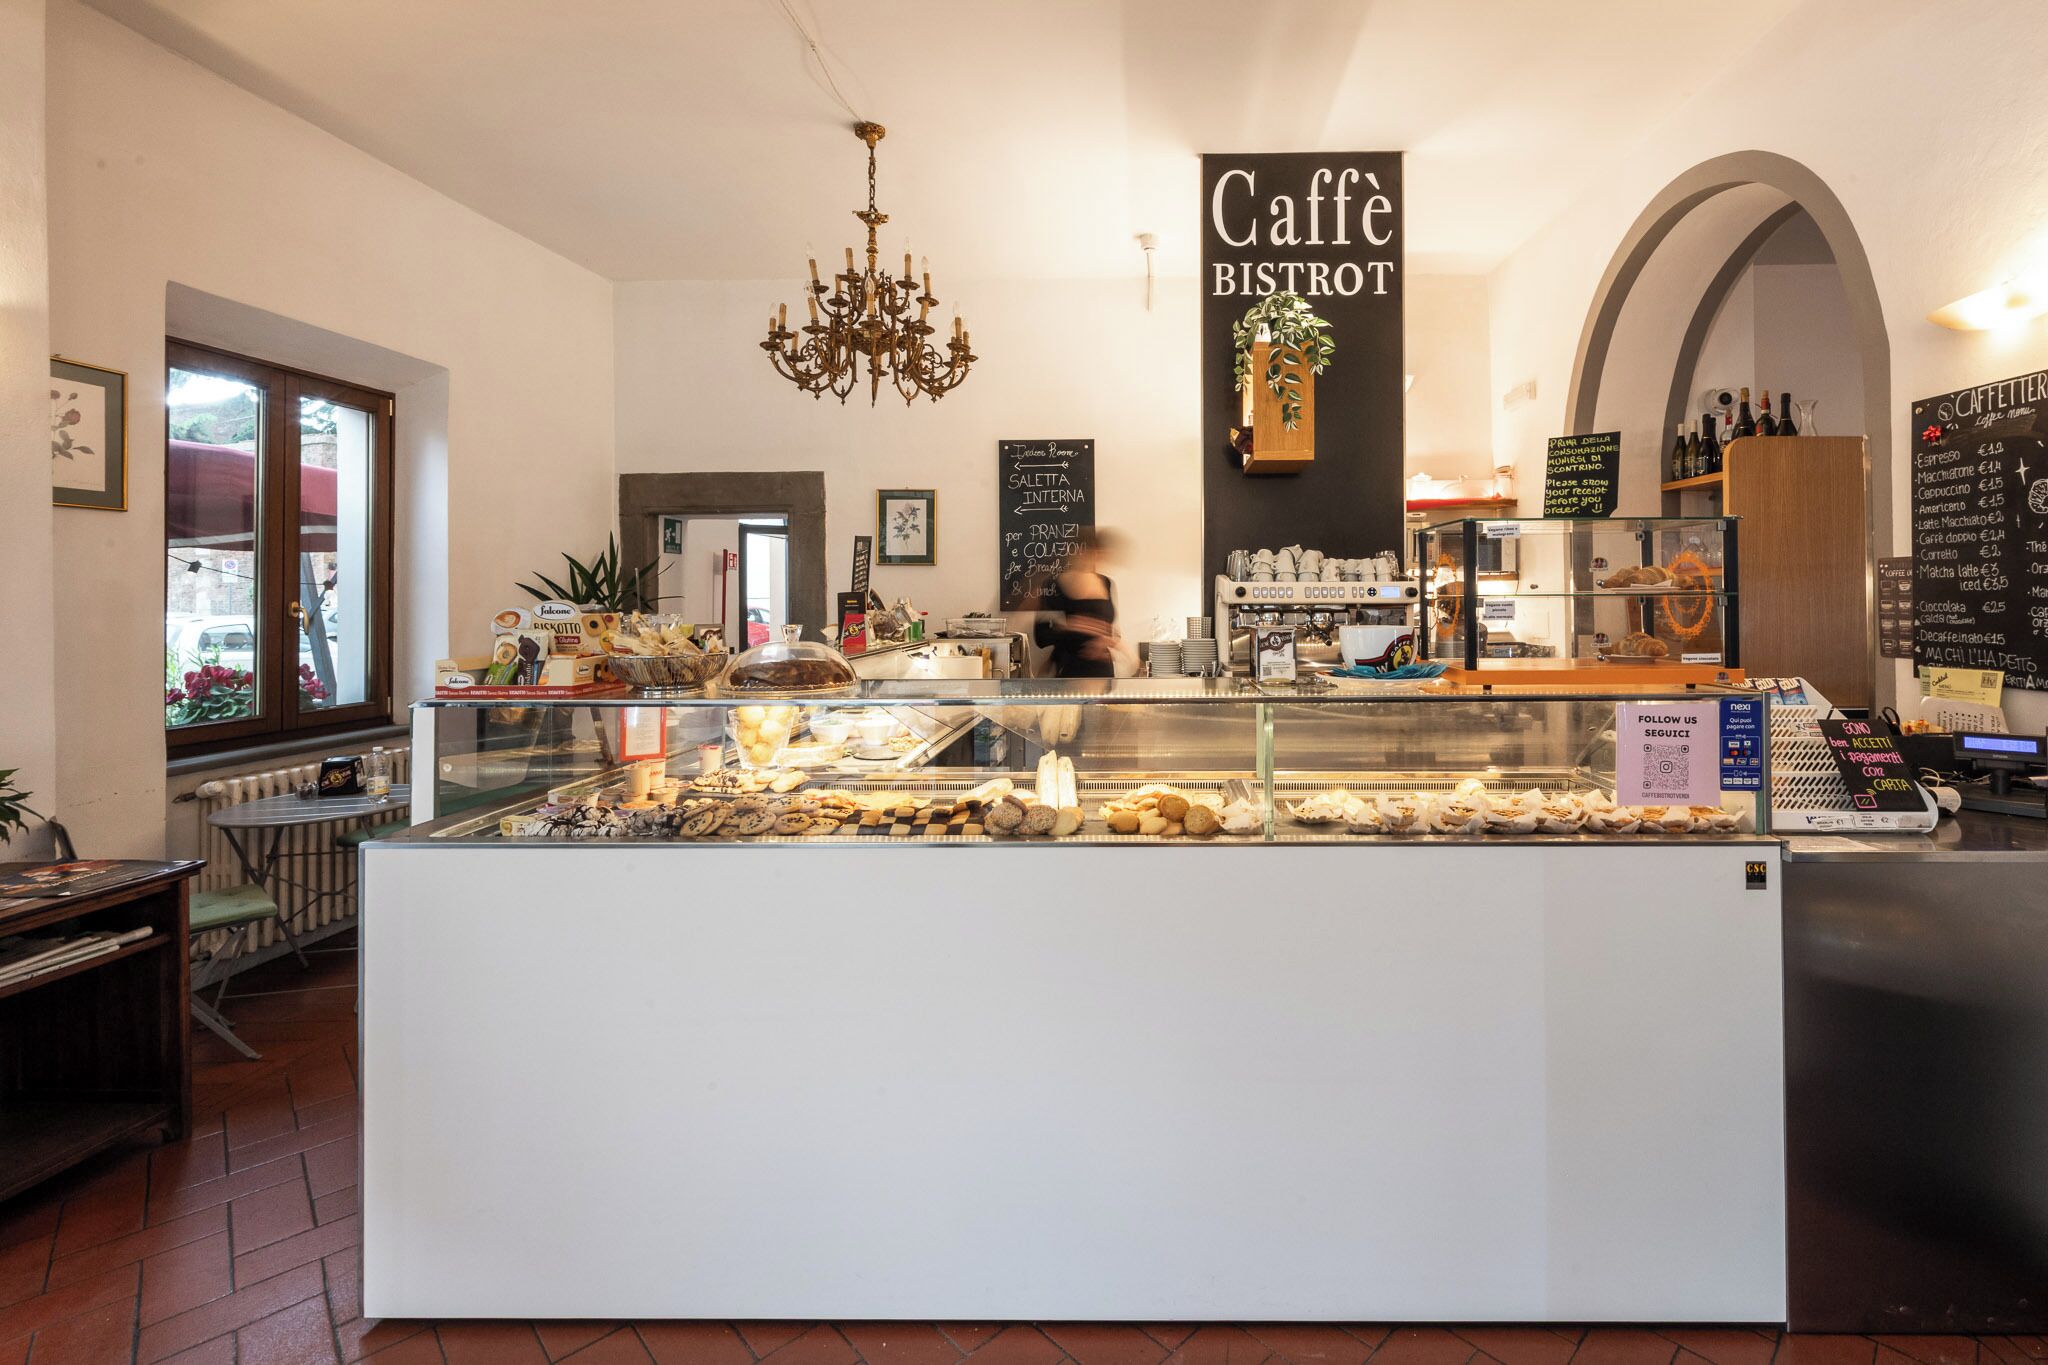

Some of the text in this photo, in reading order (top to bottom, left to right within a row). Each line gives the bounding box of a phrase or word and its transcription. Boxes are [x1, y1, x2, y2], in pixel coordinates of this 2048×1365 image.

[1212, 168, 1392, 247] Caffè
[1212, 262, 1394, 296] BISTROT
[1975, 411, 2005, 429] coffee
[1549, 436, 1611, 448] PRIMA DELLA
[1548, 445, 1620, 457] CONSUMAZIONE
[1548, 455, 1586, 466] MUNIRSI
[1917, 450, 1961, 469] Espresso
[1007, 473, 1071, 489] SALETTA
[1546, 479, 1578, 487] Please
[1022, 489, 1085, 505] INTERNA
[1545, 487, 1608, 498] your receipt
[1918, 484, 1971, 500] Cappuccino
[1545, 497, 1601, 506] before you
[1919, 501, 1966, 514] Americano
[1918, 519, 1940, 530] Latte
[1941, 515, 1987, 528] Macchiato
[1005, 523, 1079, 547] per PRANZI
[1919, 532, 1944, 545] Caffè
[1945, 531, 1978, 544] doppio
[1011, 548, 1019, 557] e
[1920, 548, 1959, 561] Corretto
[1920, 563, 1955, 579] Matcha
[1957, 563, 1980, 578] latte
[1959, 578, 1982, 592] iced
[540, 605, 571, 616] falcone
[1919, 599, 1966, 613] Cioccolata
[1920, 613, 1945, 624] calda
[1920, 629, 1983, 644] Decaffeinato
[1925, 647, 1943, 662] MA
[1998, 652, 2037, 673] DETTO
[1730, 703, 1751, 711] nexi
[1638, 715, 1697, 724] FOLLOW US
[1644, 729, 1690, 738] SEGUICI
[1842, 722, 1871, 735] SONO
[1829, 736, 1850, 748] ben
[1839, 750, 1904, 765] i pagamenti
[1873, 778, 1912, 791] CARTA
[1746, 863, 1766, 873] CSC
